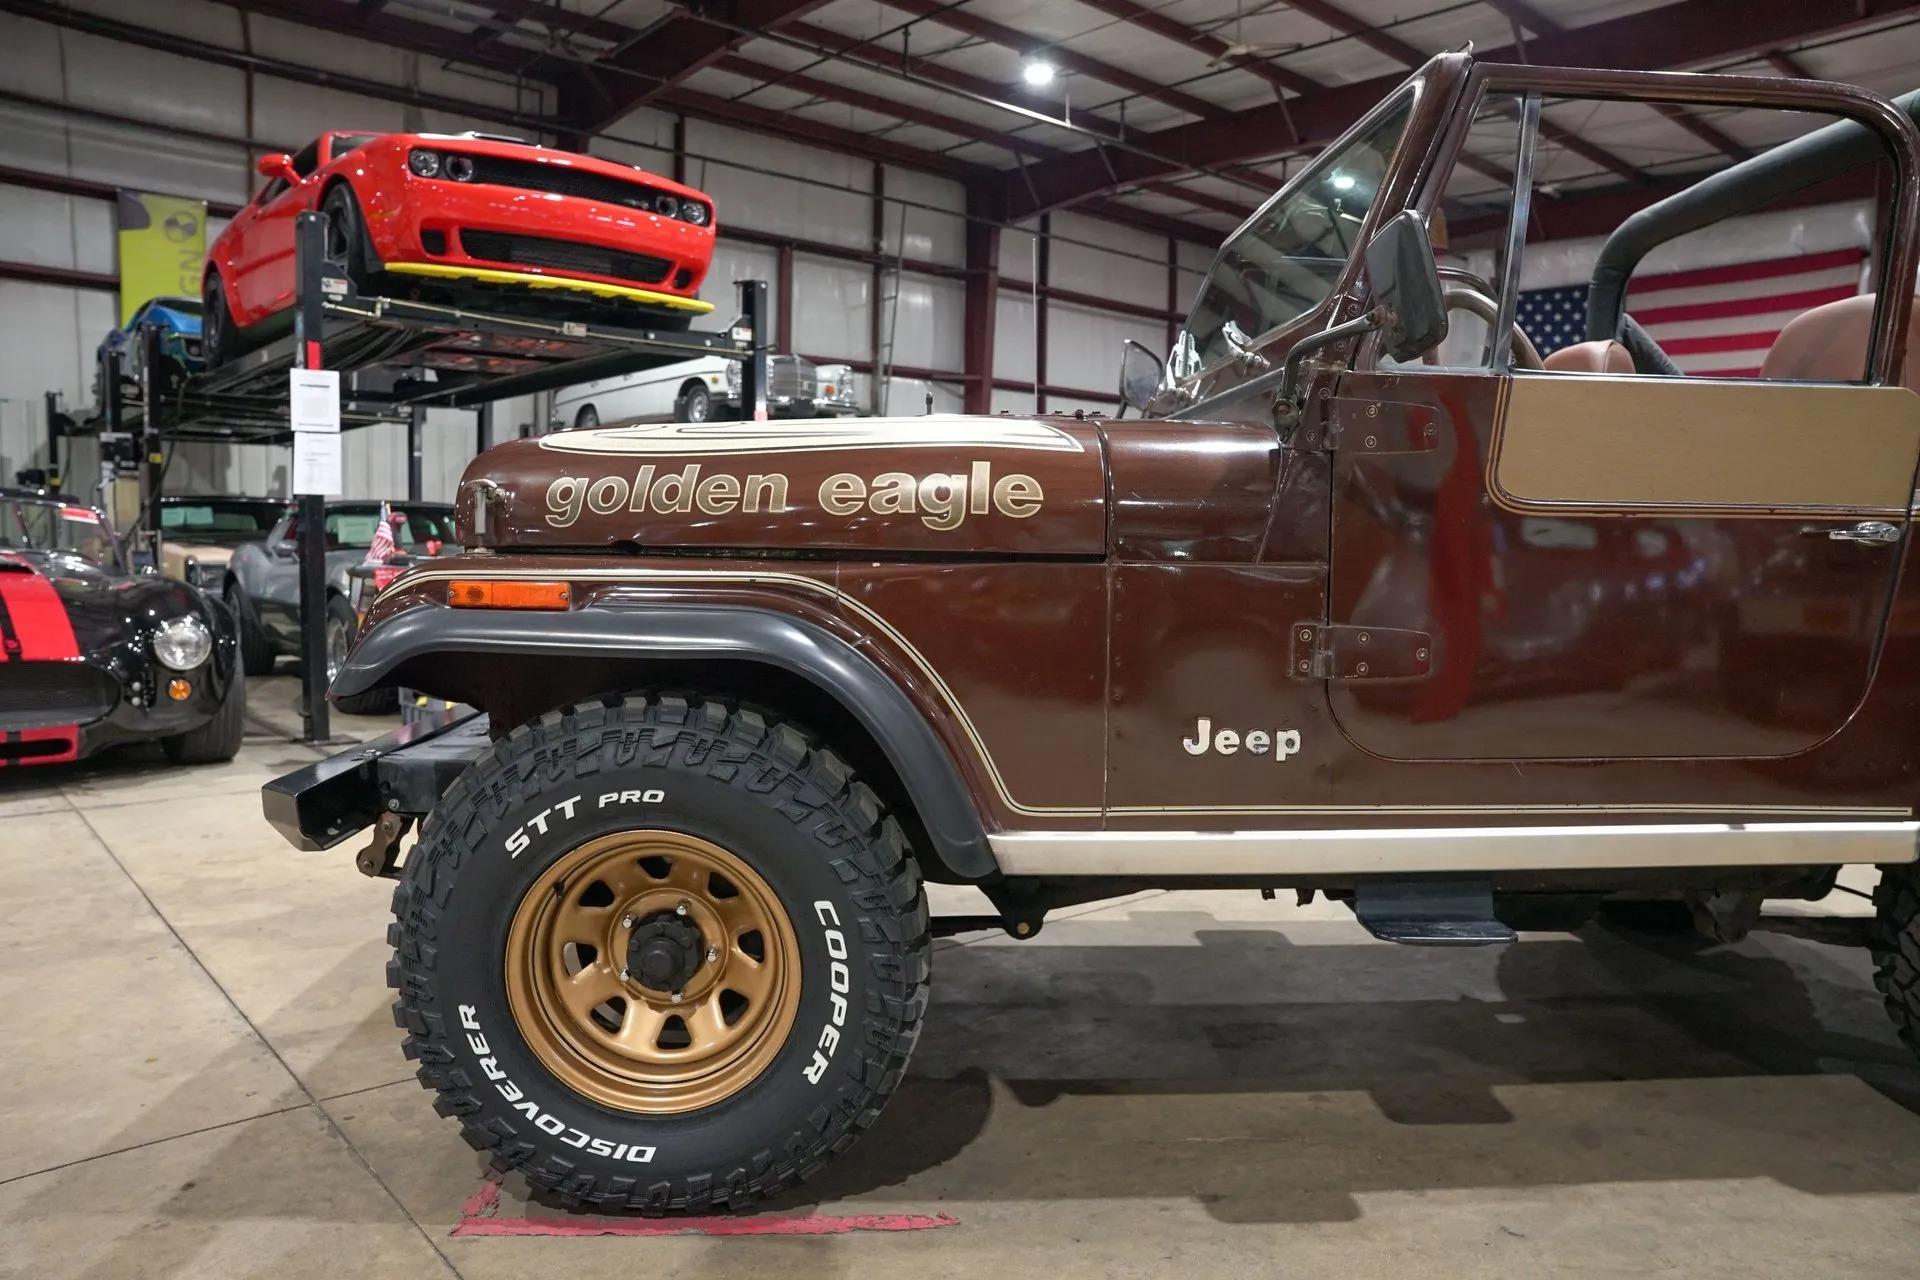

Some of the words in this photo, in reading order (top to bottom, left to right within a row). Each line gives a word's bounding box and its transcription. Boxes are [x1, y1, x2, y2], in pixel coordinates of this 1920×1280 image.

[546, 464, 789, 528] golden
[818, 461, 1044, 530] eagle
[1183, 717, 1301, 762] Jeep
[504, 795, 582, 859] STT
[598, 789, 665, 808] PRO
[802, 900, 850, 1086] COOPER
[458, 1004, 657, 1163] DISCOVERER
